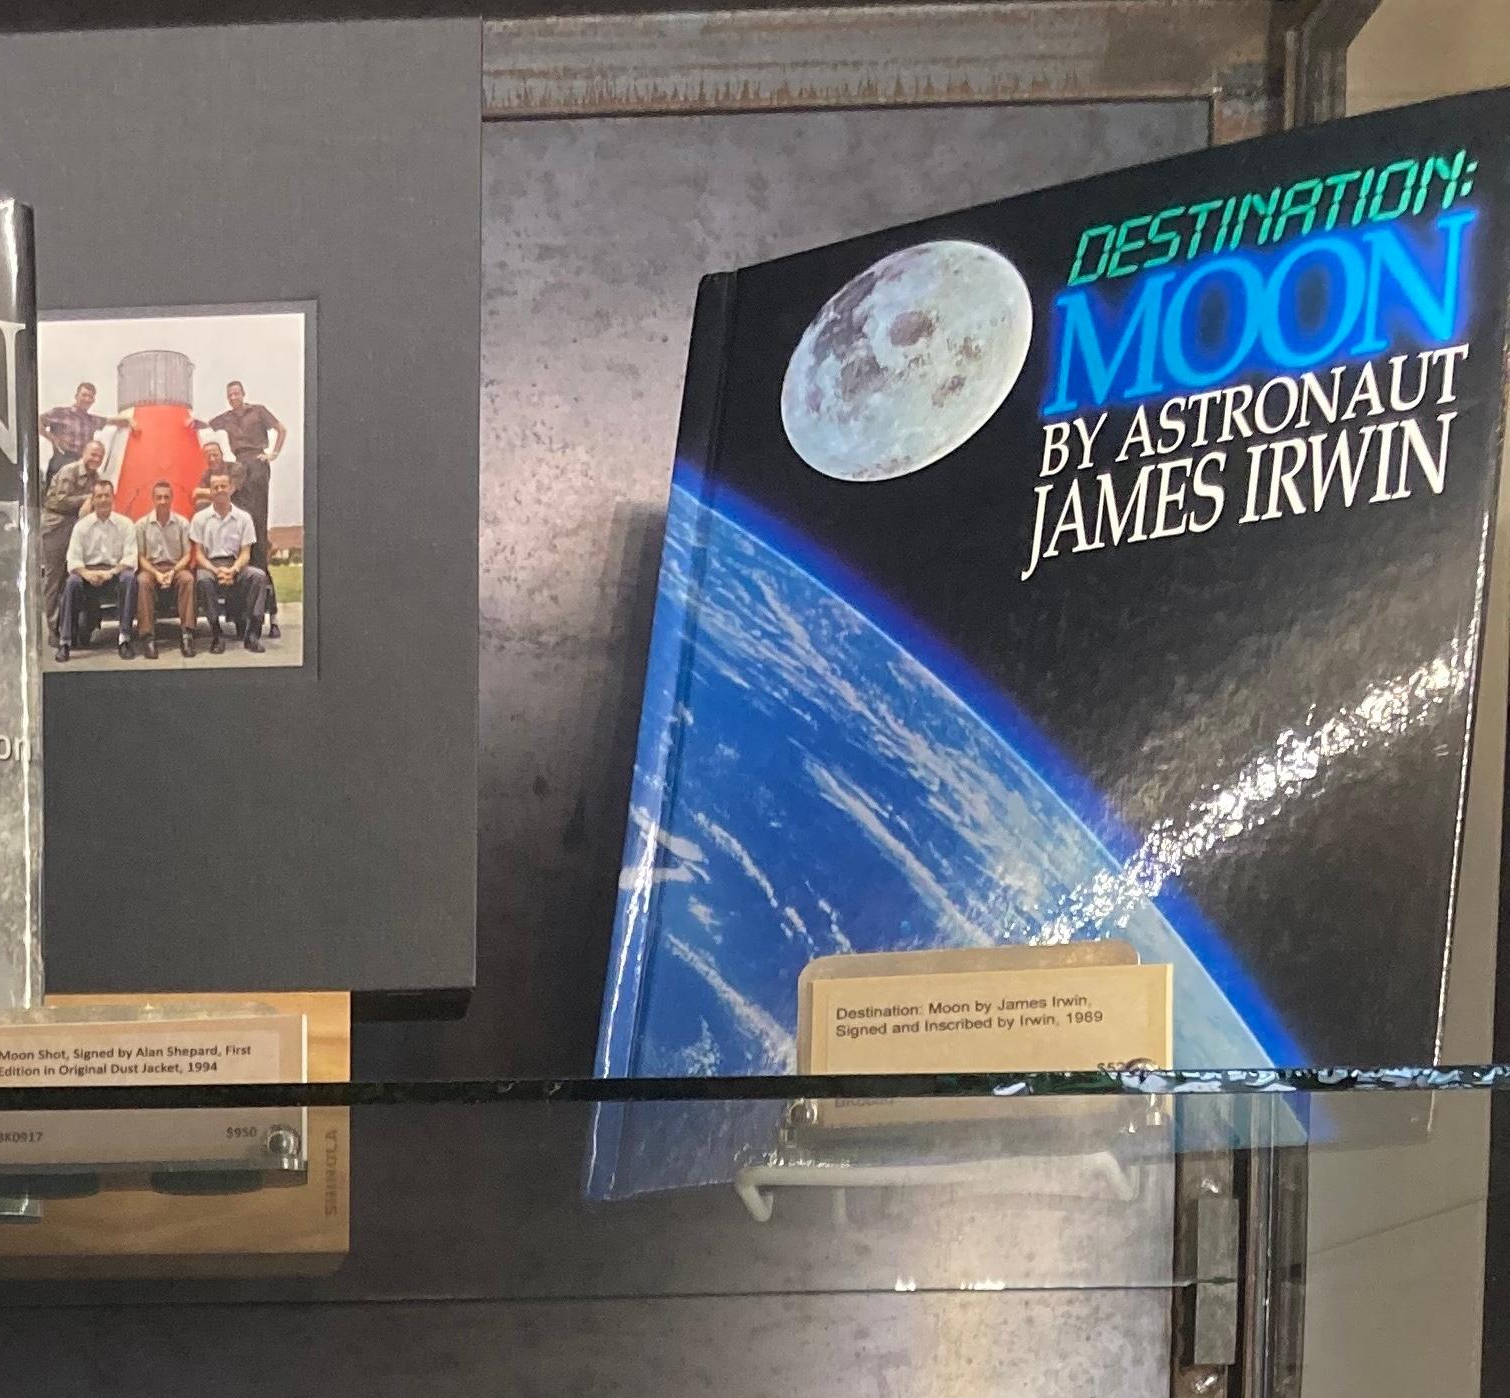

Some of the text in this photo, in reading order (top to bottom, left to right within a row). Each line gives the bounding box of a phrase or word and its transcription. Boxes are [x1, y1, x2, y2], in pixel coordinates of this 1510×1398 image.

[1068, 149, 1479, 288] DESTINATION:
[1041, 209, 1476, 416] MOON
[1039, 345, 1469, 478] BY ASTRONAUT
[1021, 412, 1458, 581] JAMES IRWIN
[928, 994, 1092, 1015] Moon James Irwin,
[835, 1023, 888, 1039] Signed
[925, 1015, 992, 1033] Inscribed
[1020, 1012, 1060, 1027] Irwin,
[39, 1050, 70, 1061] Shot,
[74, 1048, 115, 1061] Signed
[136, 1047, 163, 1058] Alan
[167, 1045, 221, 1058] Shepard,
[226, 1045, 251, 1056] First
[59, 1064, 107, 1077] Original
[111, 1064, 138, 1075] Dust
[142, 1063, 183, 1075] Jacket,
[188, 1062, 218, 1073] 1994
[226, 1127, 257, 1140] $950
